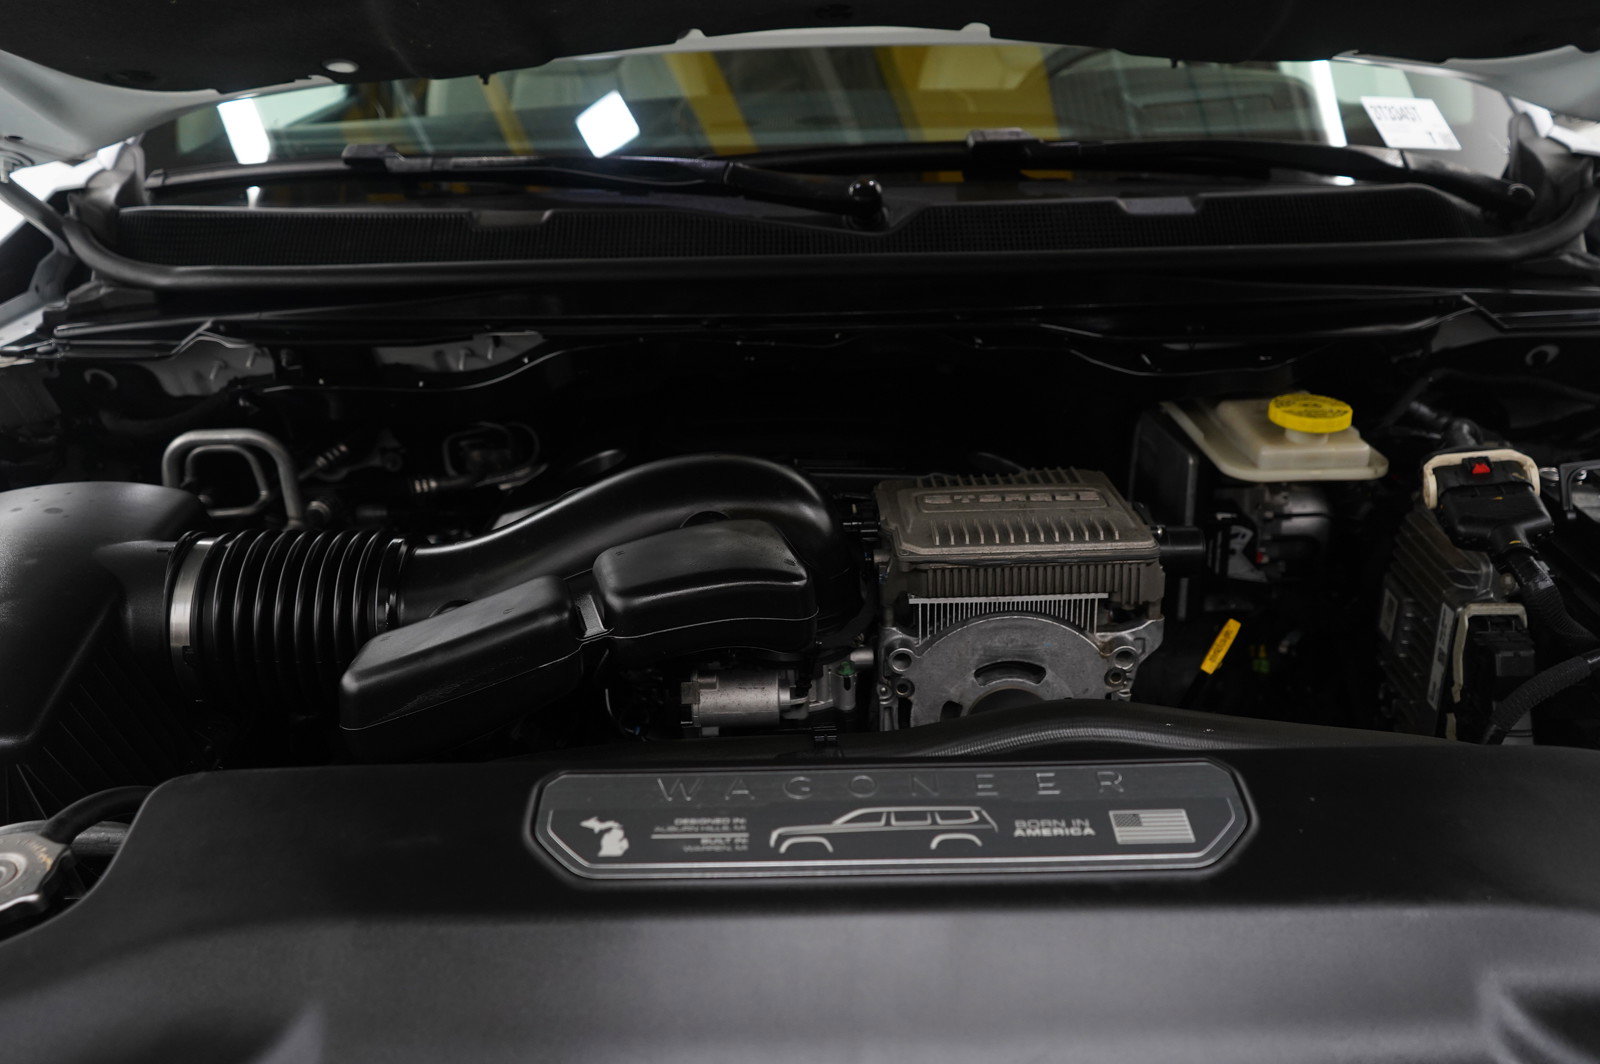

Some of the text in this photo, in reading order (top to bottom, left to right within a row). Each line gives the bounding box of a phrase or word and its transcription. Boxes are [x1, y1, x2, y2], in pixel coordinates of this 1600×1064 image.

[656, 771, 1124, 801] WAGONEER
[1014, 818, 1090, 829] BORN IN
[1013, 827, 1096, 838] AMERICA
